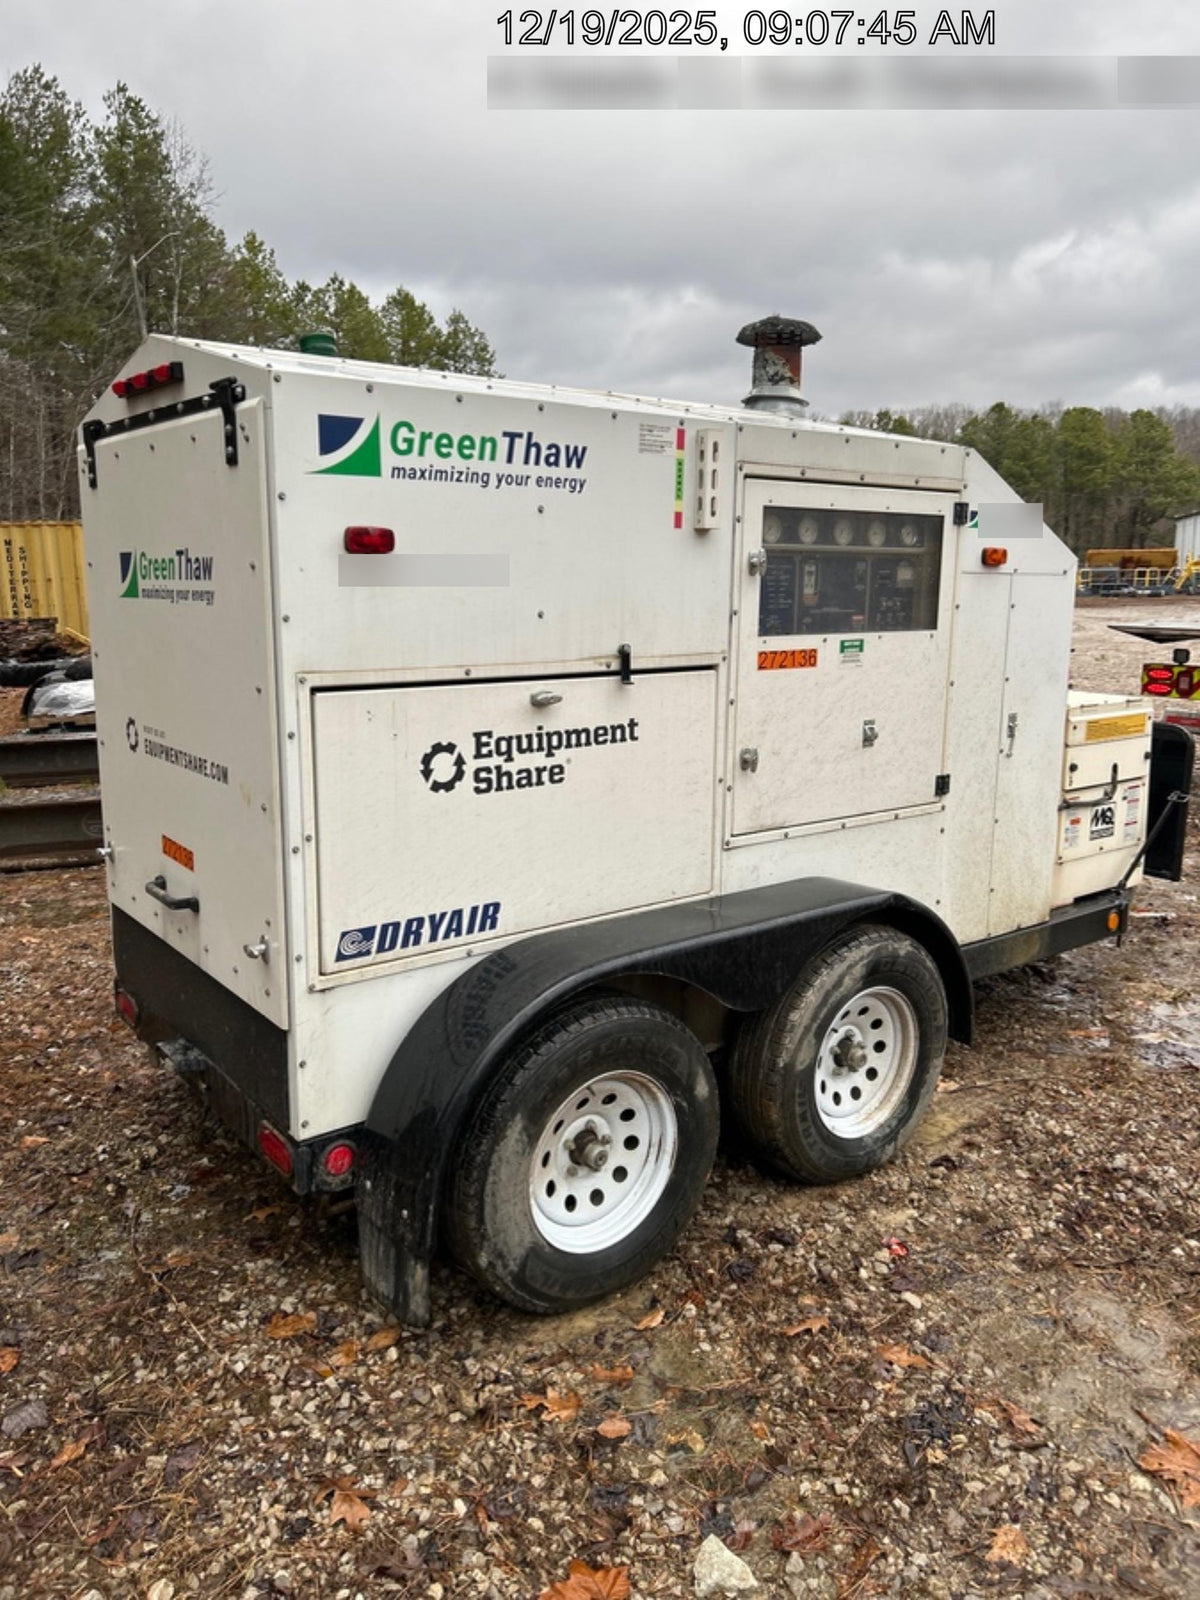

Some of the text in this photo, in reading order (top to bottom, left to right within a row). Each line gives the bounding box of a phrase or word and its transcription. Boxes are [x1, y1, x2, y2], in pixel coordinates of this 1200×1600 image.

[389, 420, 588, 470] GreenThaw
[390, 464, 588, 494] maximizing your energy
[18, 546, 32, 609] SHIPPING
[140, 547, 214, 581] GreenThaw
[757, 649, 818, 670] 272136
[472, 717, 639, 763] Equipment
[472, 763, 565, 795] Share
[375, 901, 502, 955] DRYAIR
